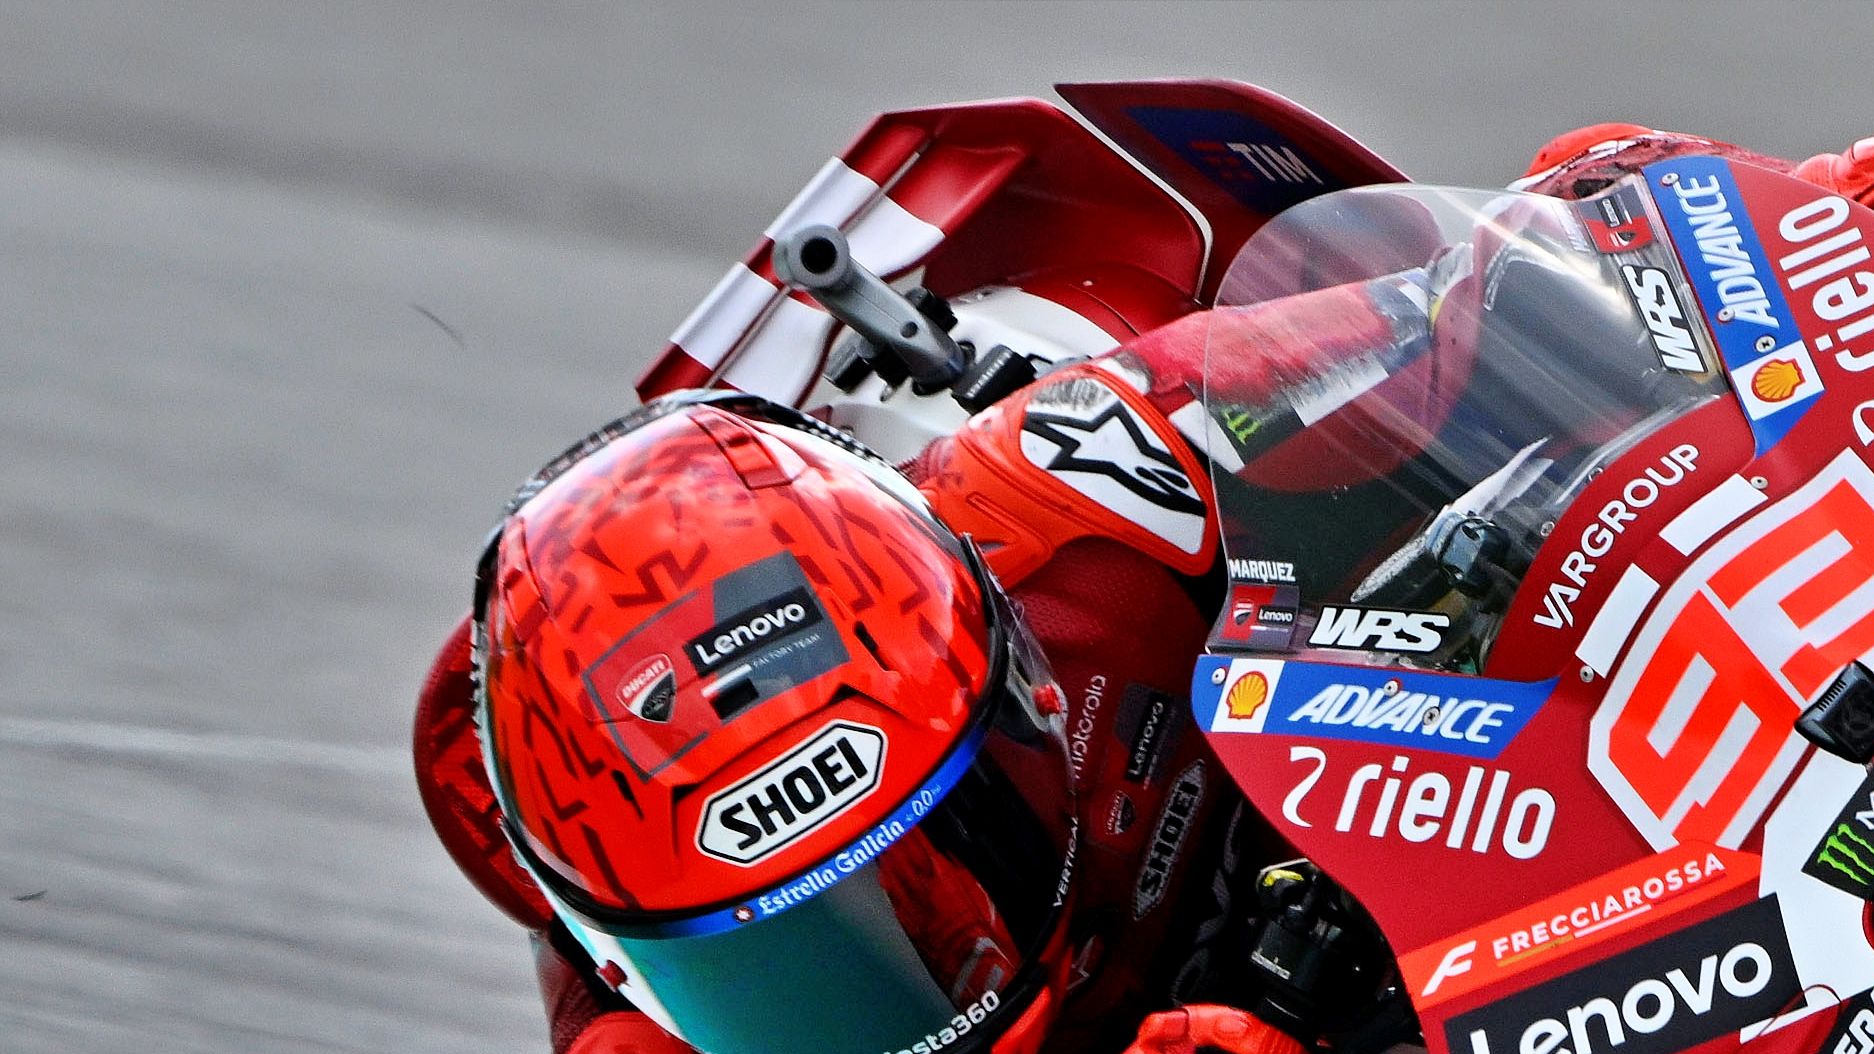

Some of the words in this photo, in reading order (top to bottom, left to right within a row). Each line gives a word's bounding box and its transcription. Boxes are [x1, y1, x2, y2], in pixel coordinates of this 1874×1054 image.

[1226, 142, 1324, 185] TIM
[1676, 173, 1780, 329] ADVANCE
[1623, 264, 1705, 373] WRS
[1227, 558, 1297, 583] MARQUEZ
[1533, 443, 1700, 630] VARGROUP
[694, 602, 806, 666] Lenovo
[1258, 608, 1294, 622] Lenovo
[1309, 607, 1450, 652] WRS
[621, 659, 667, 698] DUCATI
[1288, 683, 1515, 745] ADVANCE
[719, 736, 869, 851] SHOEI
[1335, 755, 1557, 860] riello
[757, 870, 838, 915] Estrella
[834, 820, 905, 873] Galicia
[1492, 852, 1727, 960] FRECCIAROSSA
